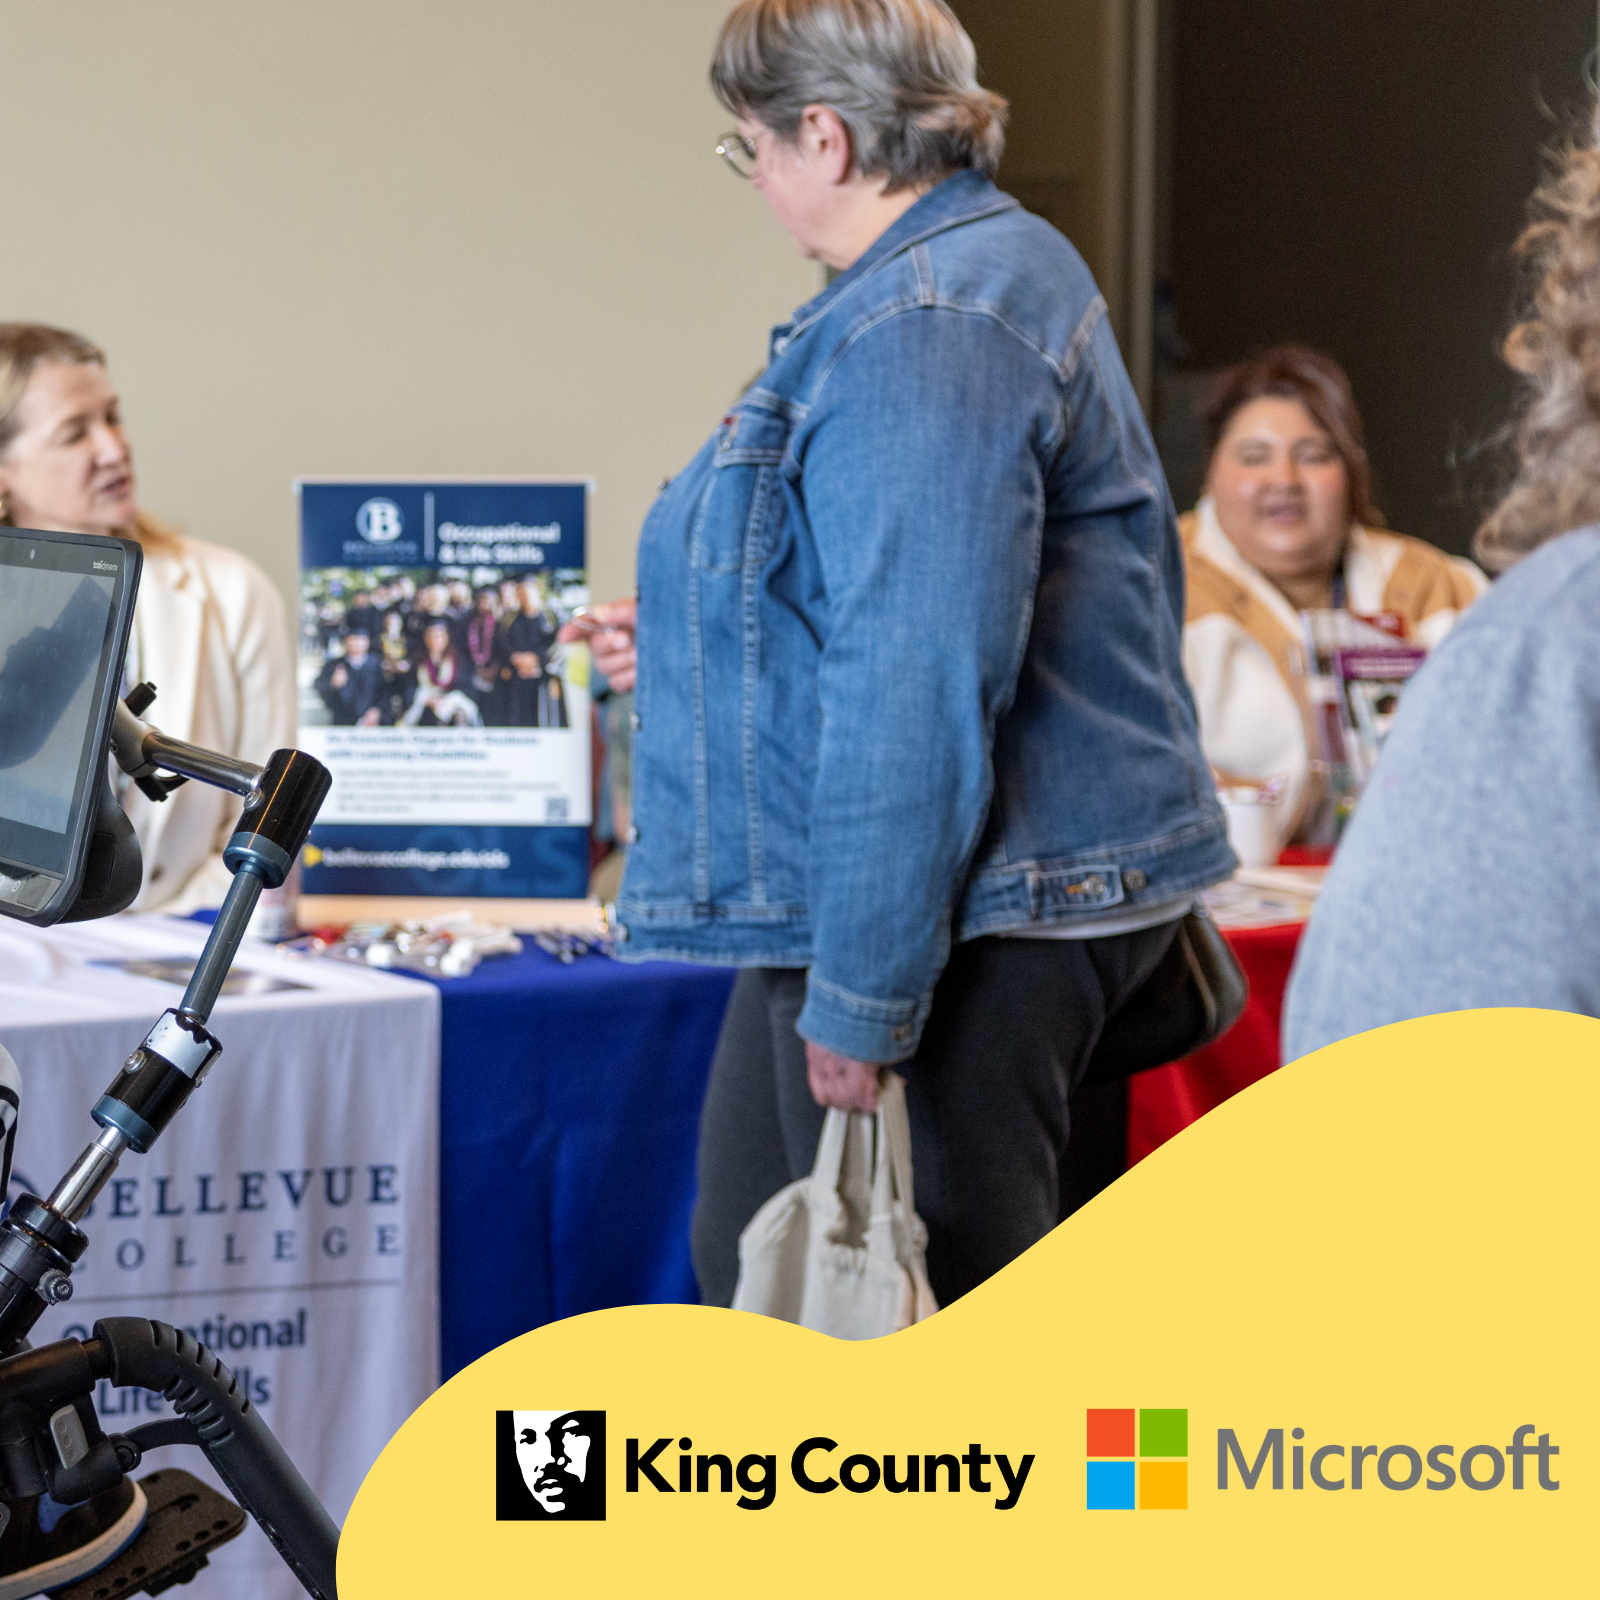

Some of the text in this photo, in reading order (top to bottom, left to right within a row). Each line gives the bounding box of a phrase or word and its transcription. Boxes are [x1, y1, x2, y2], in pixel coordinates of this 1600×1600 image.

[438, 521, 561, 545] Occupational
[492, 543, 545, 564] Skills
[84, 1163, 399, 1220] ELLEVUE
[72, 1223, 400, 1273] OLLEGE
